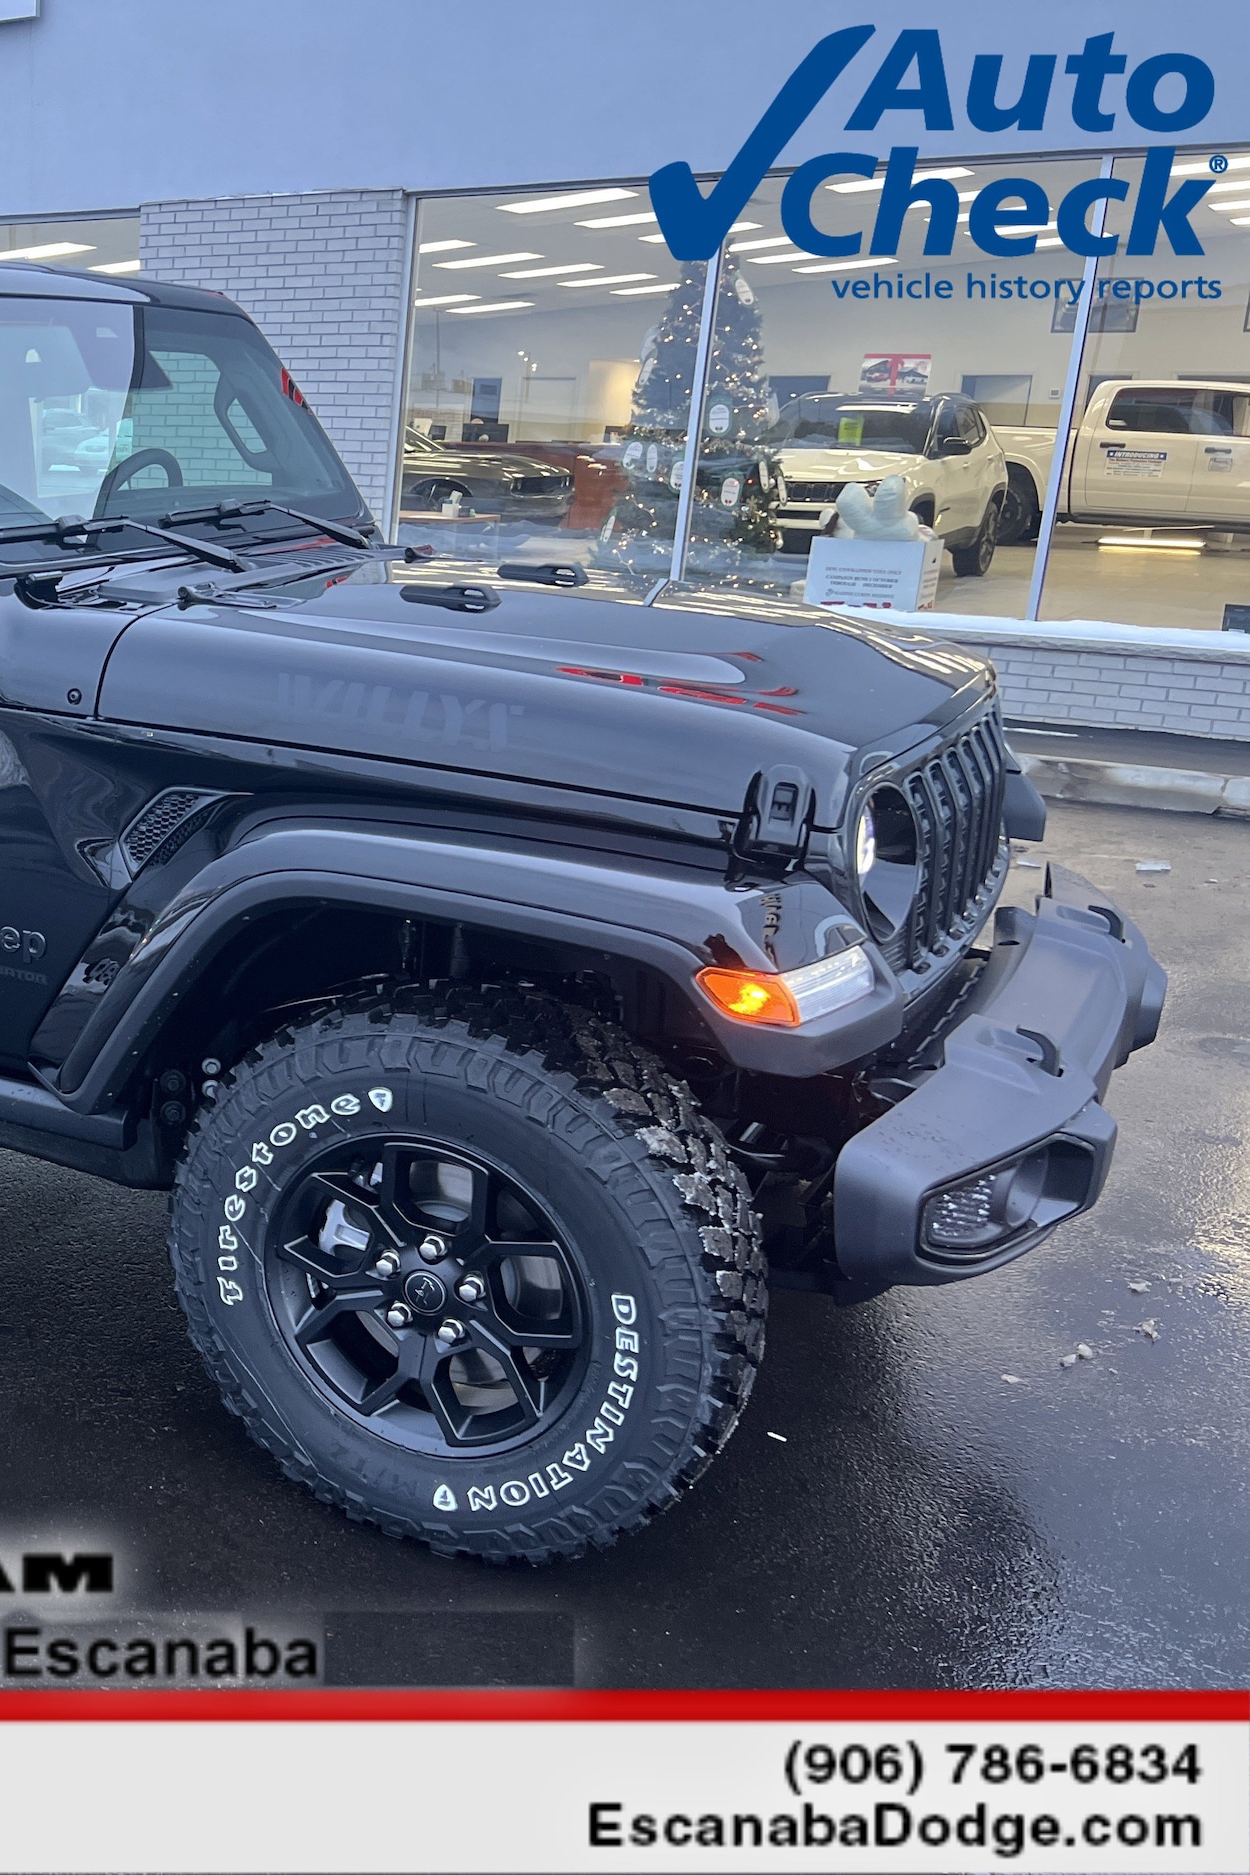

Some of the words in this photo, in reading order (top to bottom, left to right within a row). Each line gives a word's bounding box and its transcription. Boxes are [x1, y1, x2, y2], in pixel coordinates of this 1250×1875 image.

[1114, 451, 1160, 459] INTRODUCING
[217, 1092, 361, 1306] Firestone
[468, 1292, 640, 1512] DESTINATION
